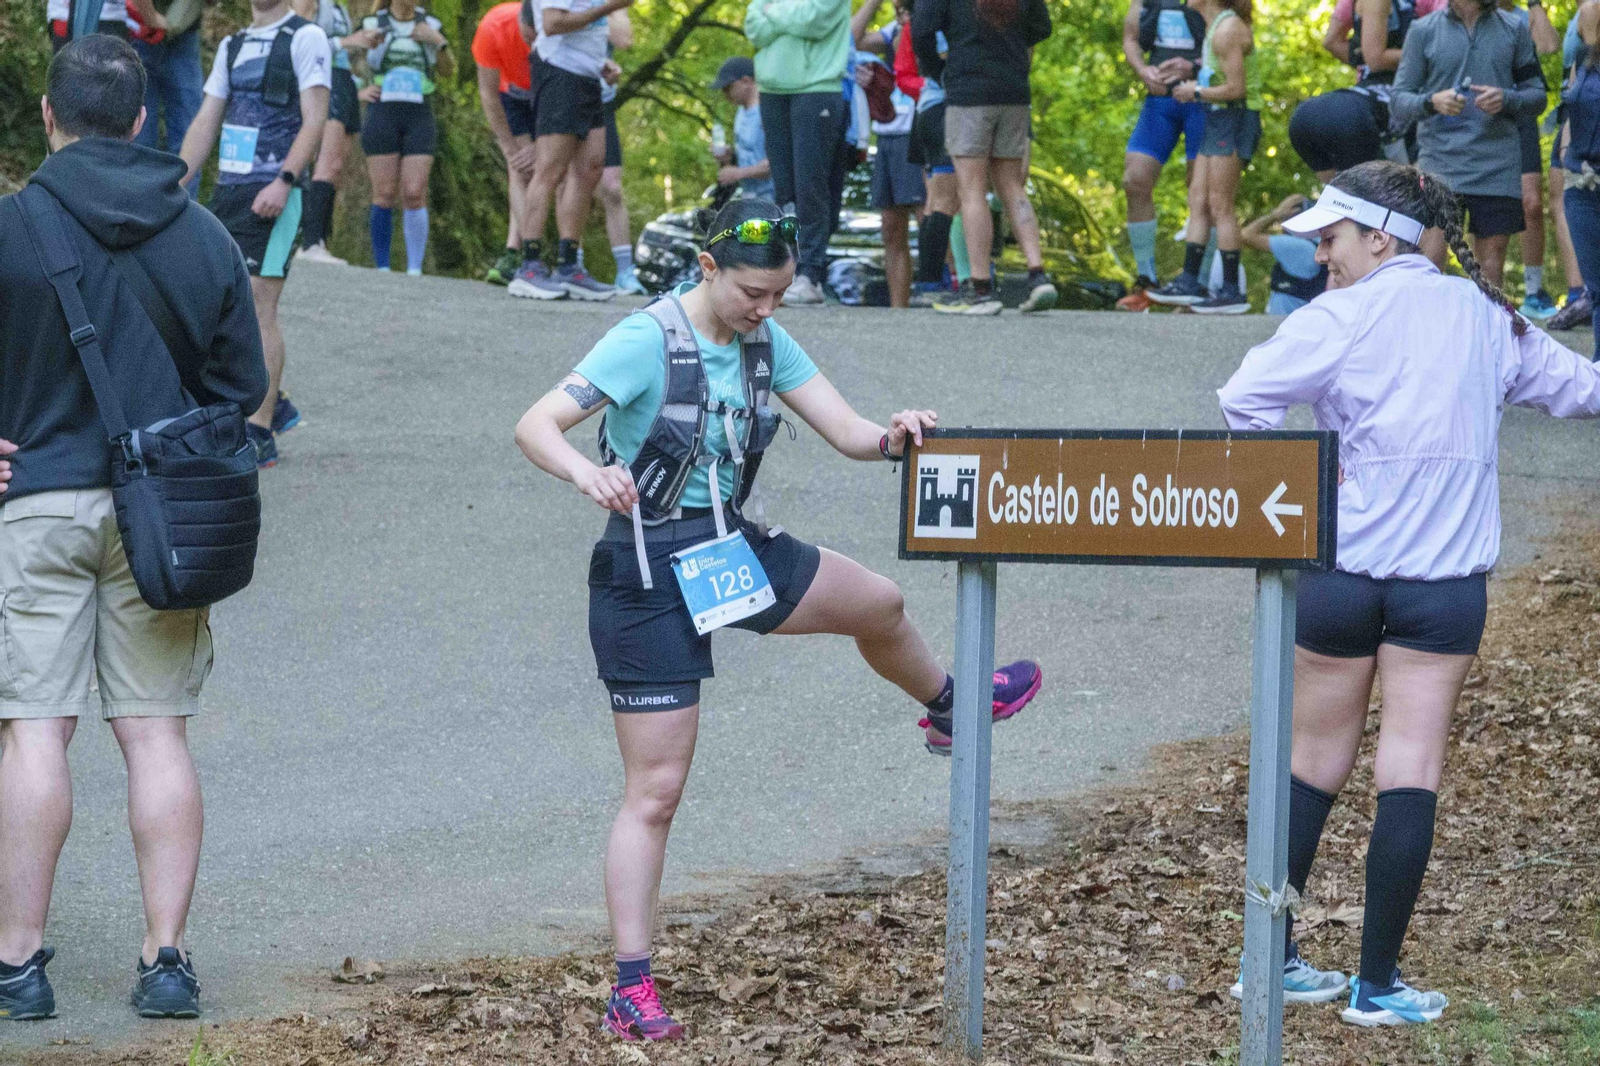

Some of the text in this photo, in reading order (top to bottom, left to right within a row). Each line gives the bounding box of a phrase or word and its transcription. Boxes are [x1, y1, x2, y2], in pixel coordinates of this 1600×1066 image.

[1333, 200, 1353, 210] KIPRUN
[987, 471, 1239, 529] Castelo de Sobroso
[709, 565, 754, 600] 128
[629, 695, 678, 705] LURBEL
